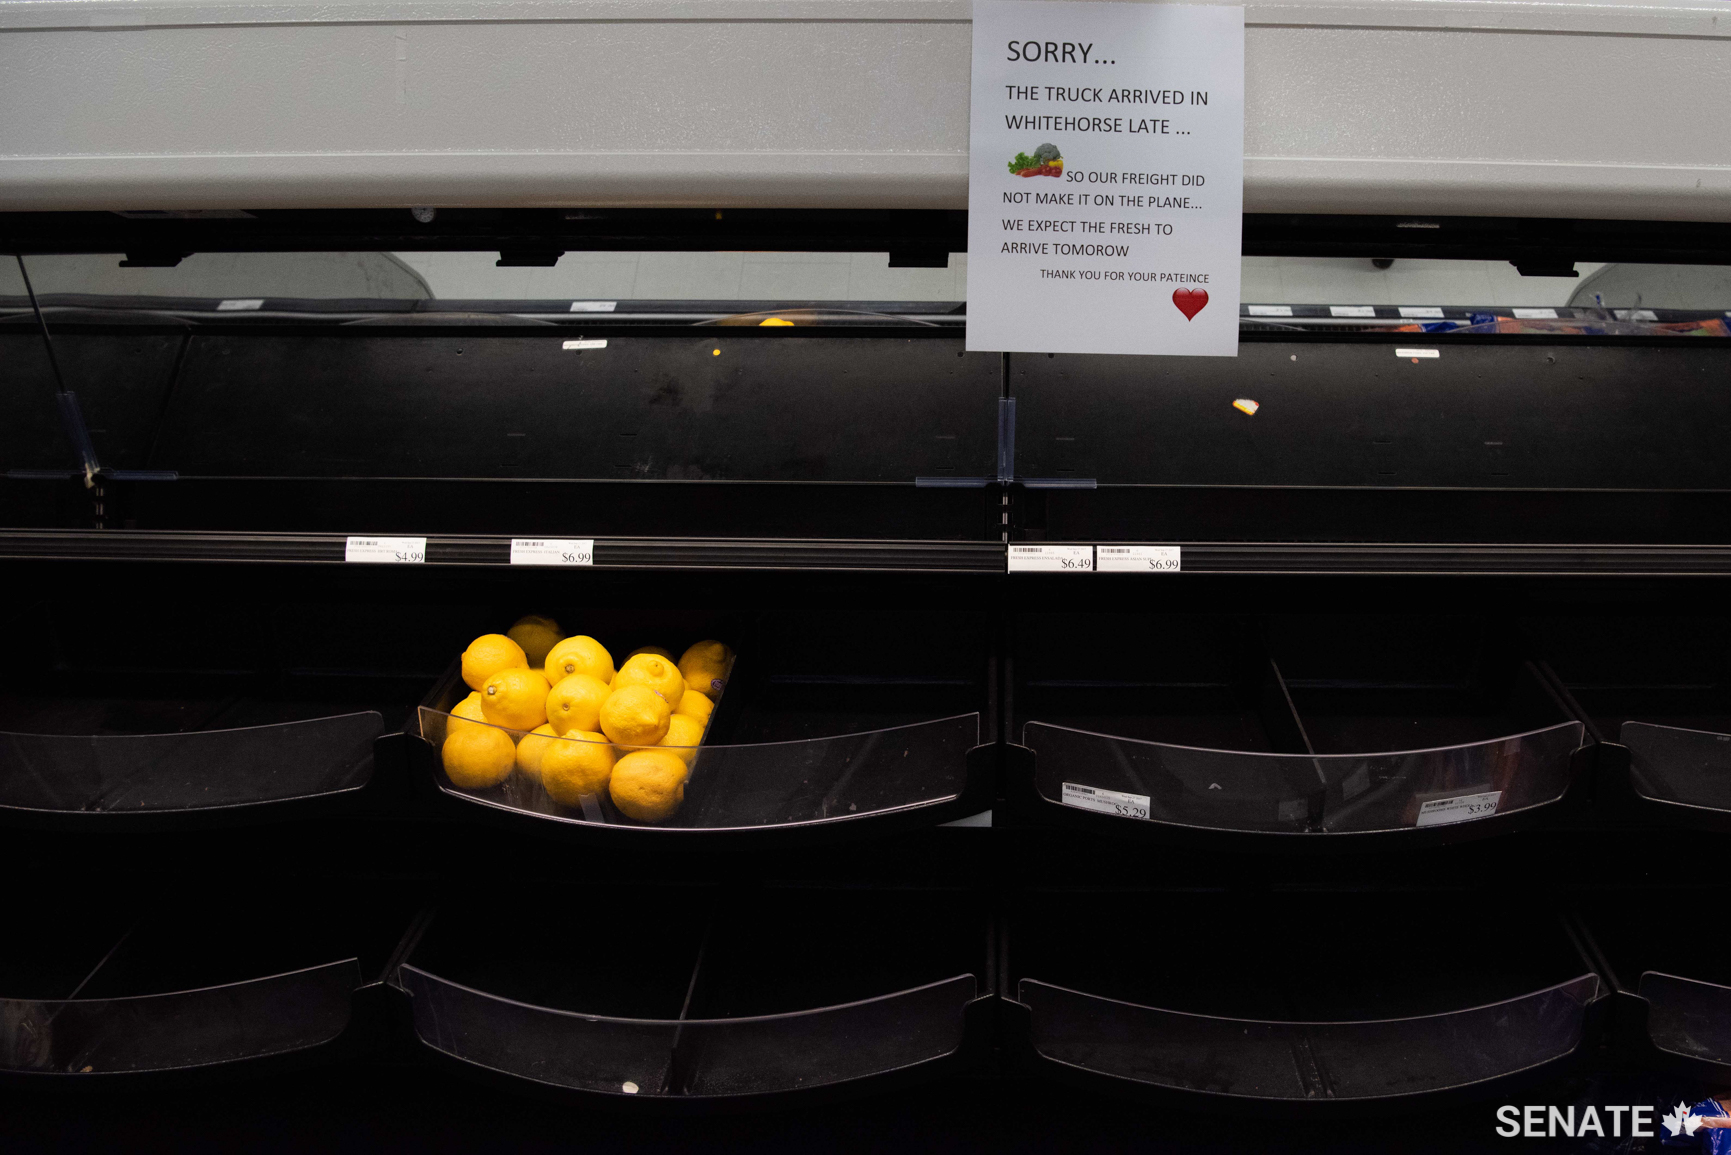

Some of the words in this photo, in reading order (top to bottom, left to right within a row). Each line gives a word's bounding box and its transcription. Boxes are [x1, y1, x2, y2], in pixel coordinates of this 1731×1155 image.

[1006, 40, 1116, 65] SORRY...
[1005, 85, 1040, 101] THE
[1044, 86, 1103, 103] TRUCK
[1107, 88, 1185, 105] ARRIVED
[1190, 90, 1209, 106] IN
[1004, 114, 1123, 133] WHITEHORSE
[1128, 118, 1170, 135] LATE
[1065, 170, 1085, 183] SO
[1087, 171, 1118, 184] OUR
[1121, 172, 1179, 187] FREIGHT
[1181, 174, 1205, 187] DID
[1002, 191, 1033, 204] NOT
[1035, 192, 1075, 206] MAKE
[1078, 193, 1091, 206] IT
[1093, 193, 1115, 207] ON
[1117, 194, 1144, 208] THE
[1148, 195, 1203, 210] PLANE...
[1001, 218, 1024, 231] WE
[1027, 219, 1077, 233] EXPECT
[1079, 221, 1106, 234] THE
[1109, 222, 1151, 235] FRESH
[1154, 223, 1174, 236] TO
[1000, 241, 1049, 255] ARRIVE
[1052, 243, 1130, 257] TOMOROW
[1039, 269, 1076, 280] THANK
[1078, 270, 1101, 281] YOU
[1103, 270, 1125, 281] FOR
[1127, 271, 1157, 282] YOUR
[1159, 272, 1210, 284] PATEINCE
[395, 551, 424, 562] $4.99
[561, 552, 591, 563] $6.99
[1061, 558, 1091, 569] $6.49
[1148, 559, 1179, 570] $6.99
[1115, 804, 1147, 818] $5.29
[1467, 801, 1497, 815] $3.99
